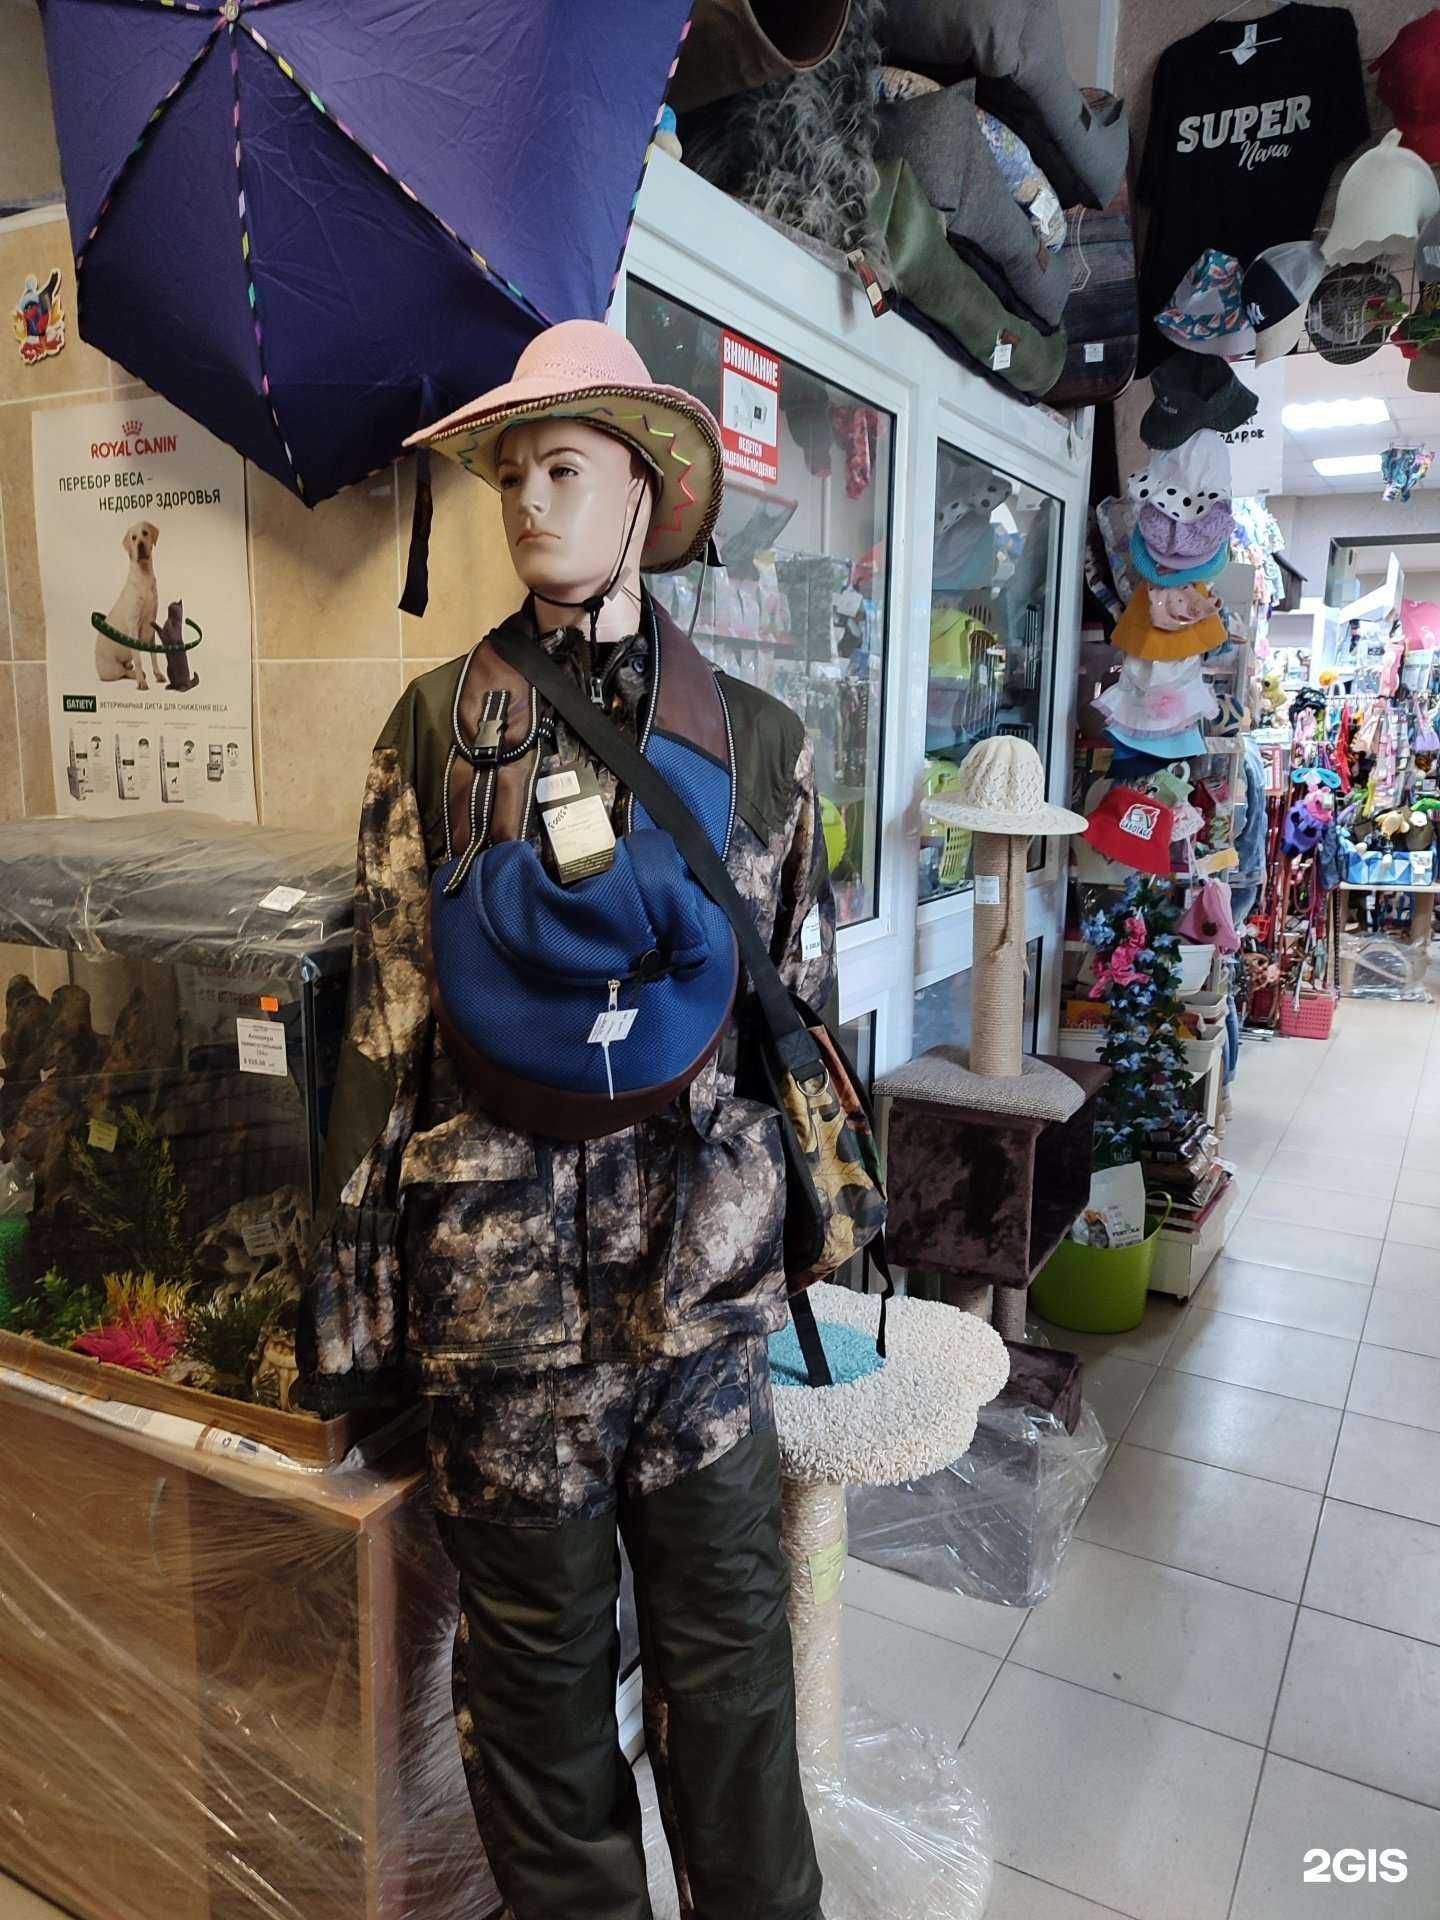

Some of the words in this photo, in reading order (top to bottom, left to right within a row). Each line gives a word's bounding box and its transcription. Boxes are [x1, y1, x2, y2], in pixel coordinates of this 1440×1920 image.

[1177, 95, 1311, 152] SUPER
[1238, 140, 1291, 170] Nana
[723, 337, 778, 387] ВНИМАНИЕ
[91, 439, 131, 459] ROYAL
[134, 435, 177, 455] CANIN
[738, 436, 762, 458] ВЕДЕТСЯ
[59, 473, 111, 492] ПЕРЕБОР
[115, 472, 144, 488] ВЕСА
[99, 494, 153, 513] НЕДОБОР
[157, 489, 221, 510] ЗДОРОВЬЯ
